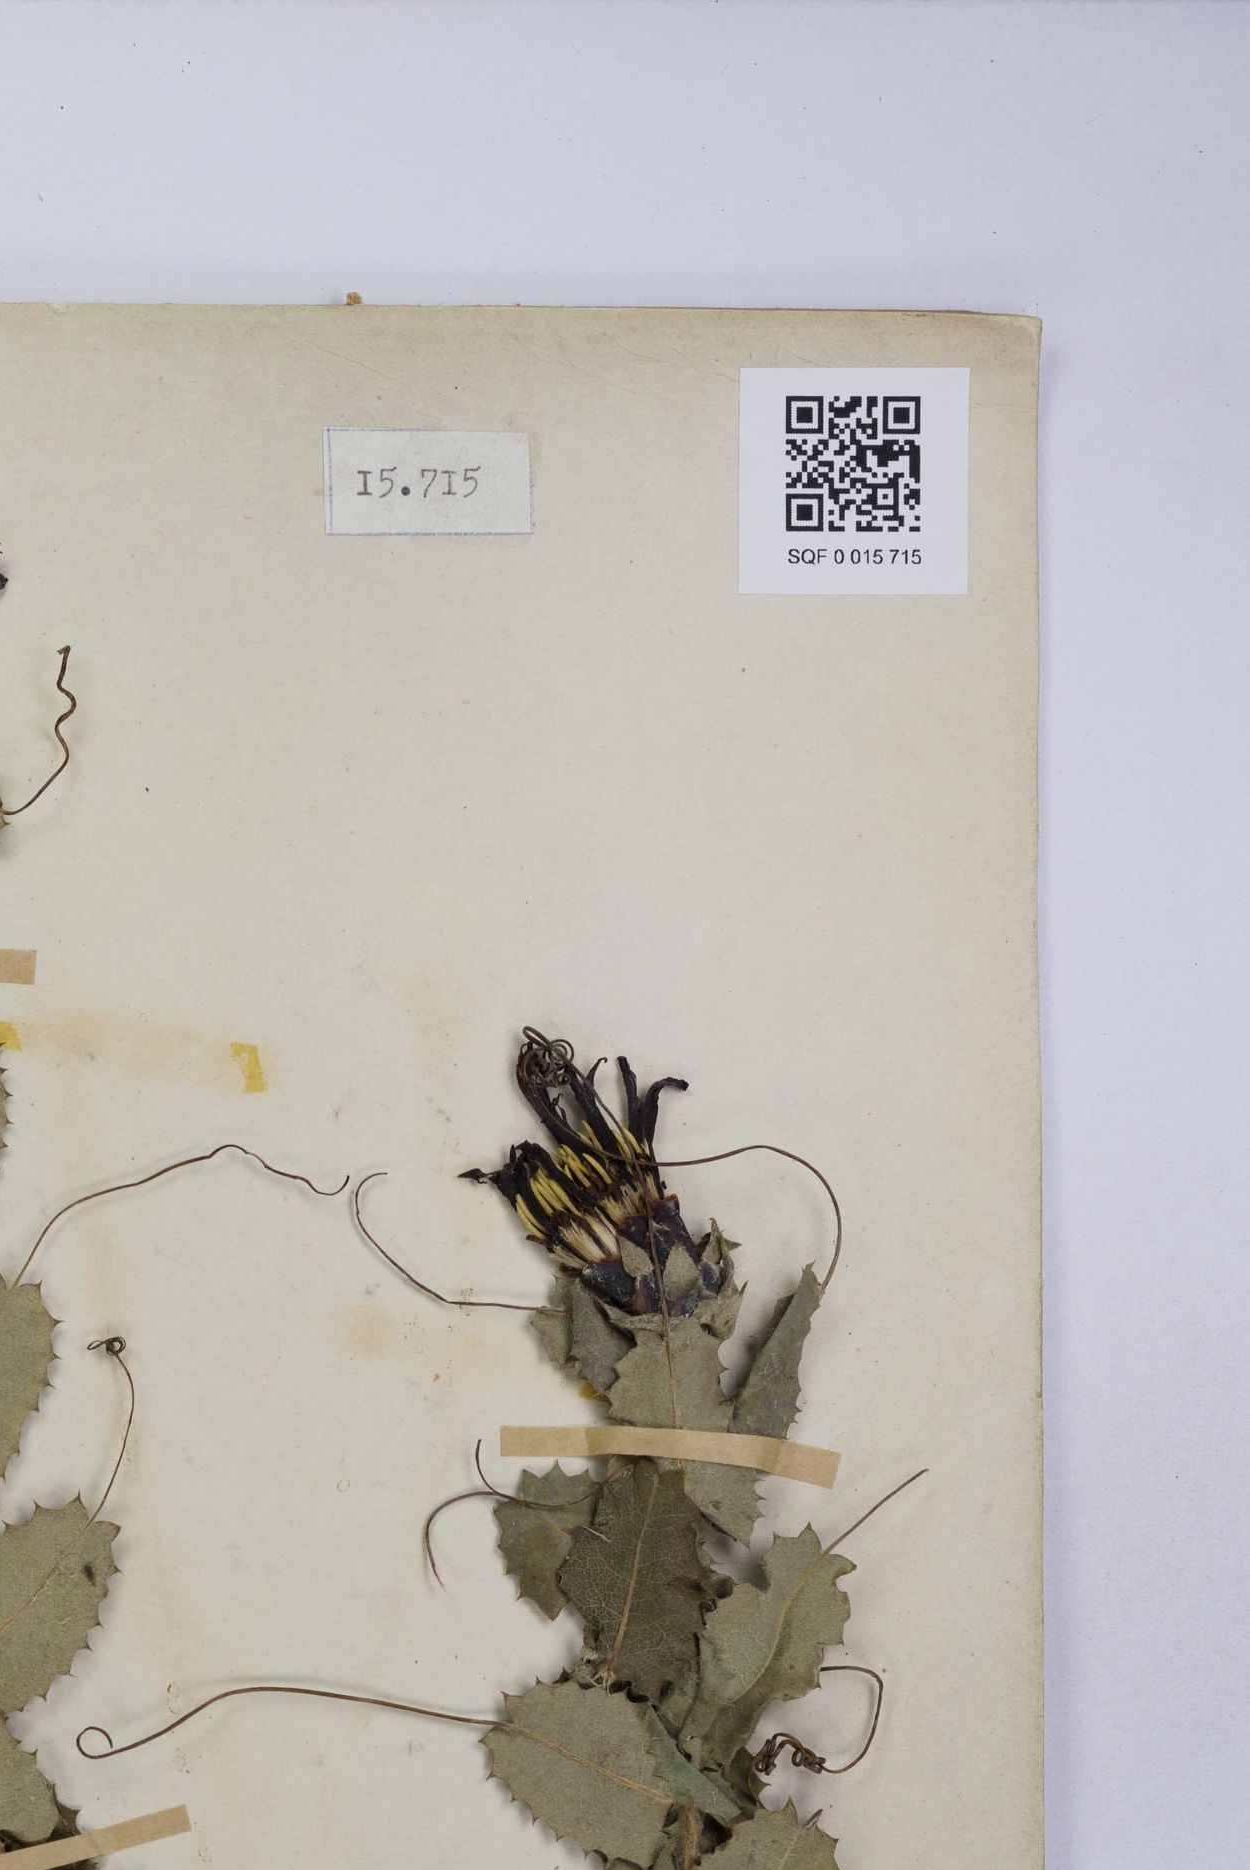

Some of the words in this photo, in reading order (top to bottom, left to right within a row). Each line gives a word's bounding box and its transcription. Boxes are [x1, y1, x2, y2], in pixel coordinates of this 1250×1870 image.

[787, 548, 828, 566] SQF
[833, 548, 845, 565] 0
[850, 548, 884, 565] 015
[889, 548, 922, 565] 715
